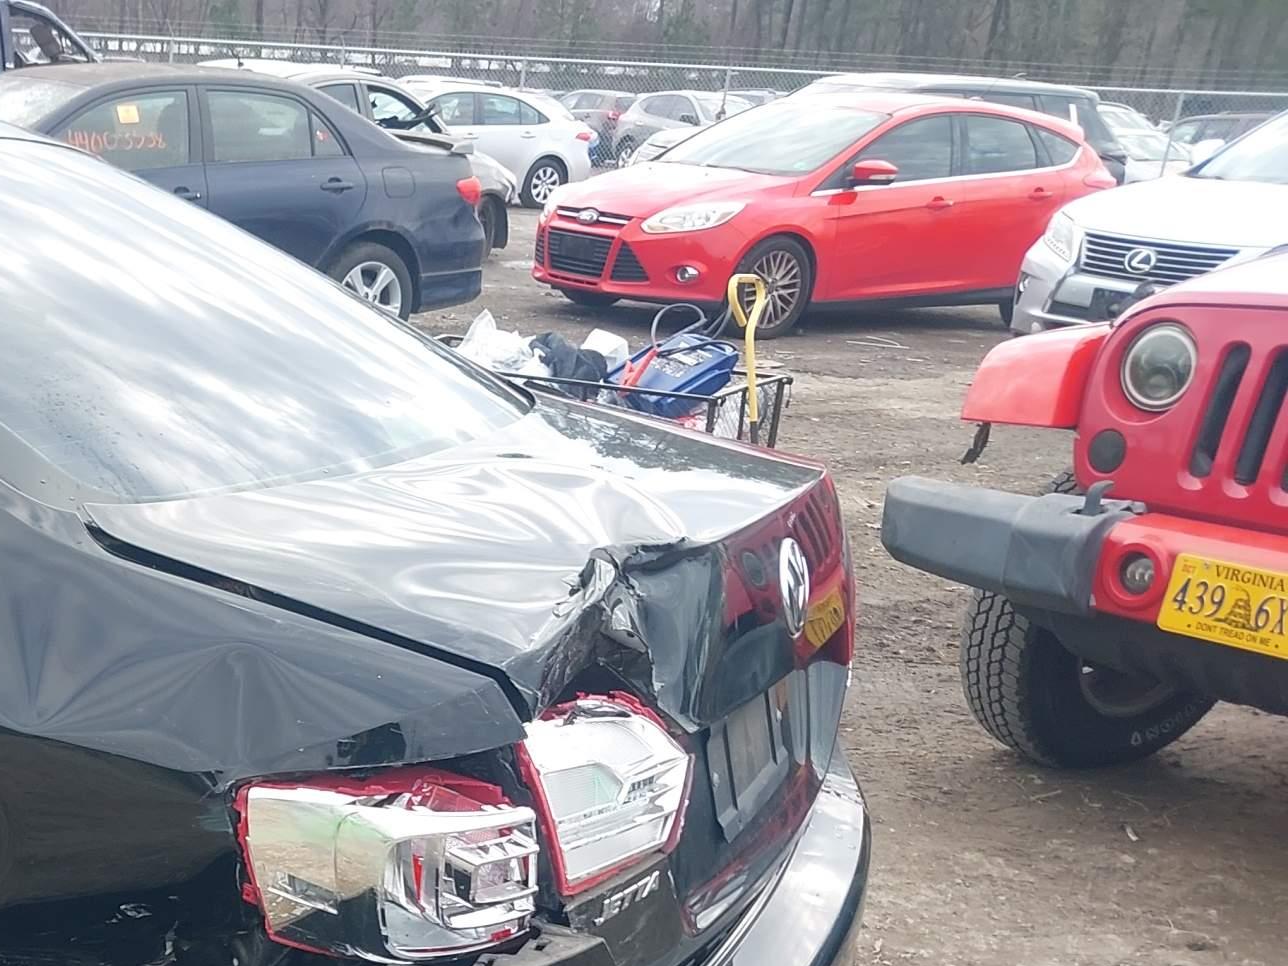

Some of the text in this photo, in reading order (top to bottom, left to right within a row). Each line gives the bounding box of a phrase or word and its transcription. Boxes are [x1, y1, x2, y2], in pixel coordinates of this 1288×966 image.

[1215, 564, 1285, 592] VIRGINIA
[1172, 577, 1226, 618] 439
[1195, 621, 1272, 647] DONT TREAD ON ME
[593, 870, 660, 927] JETTA
